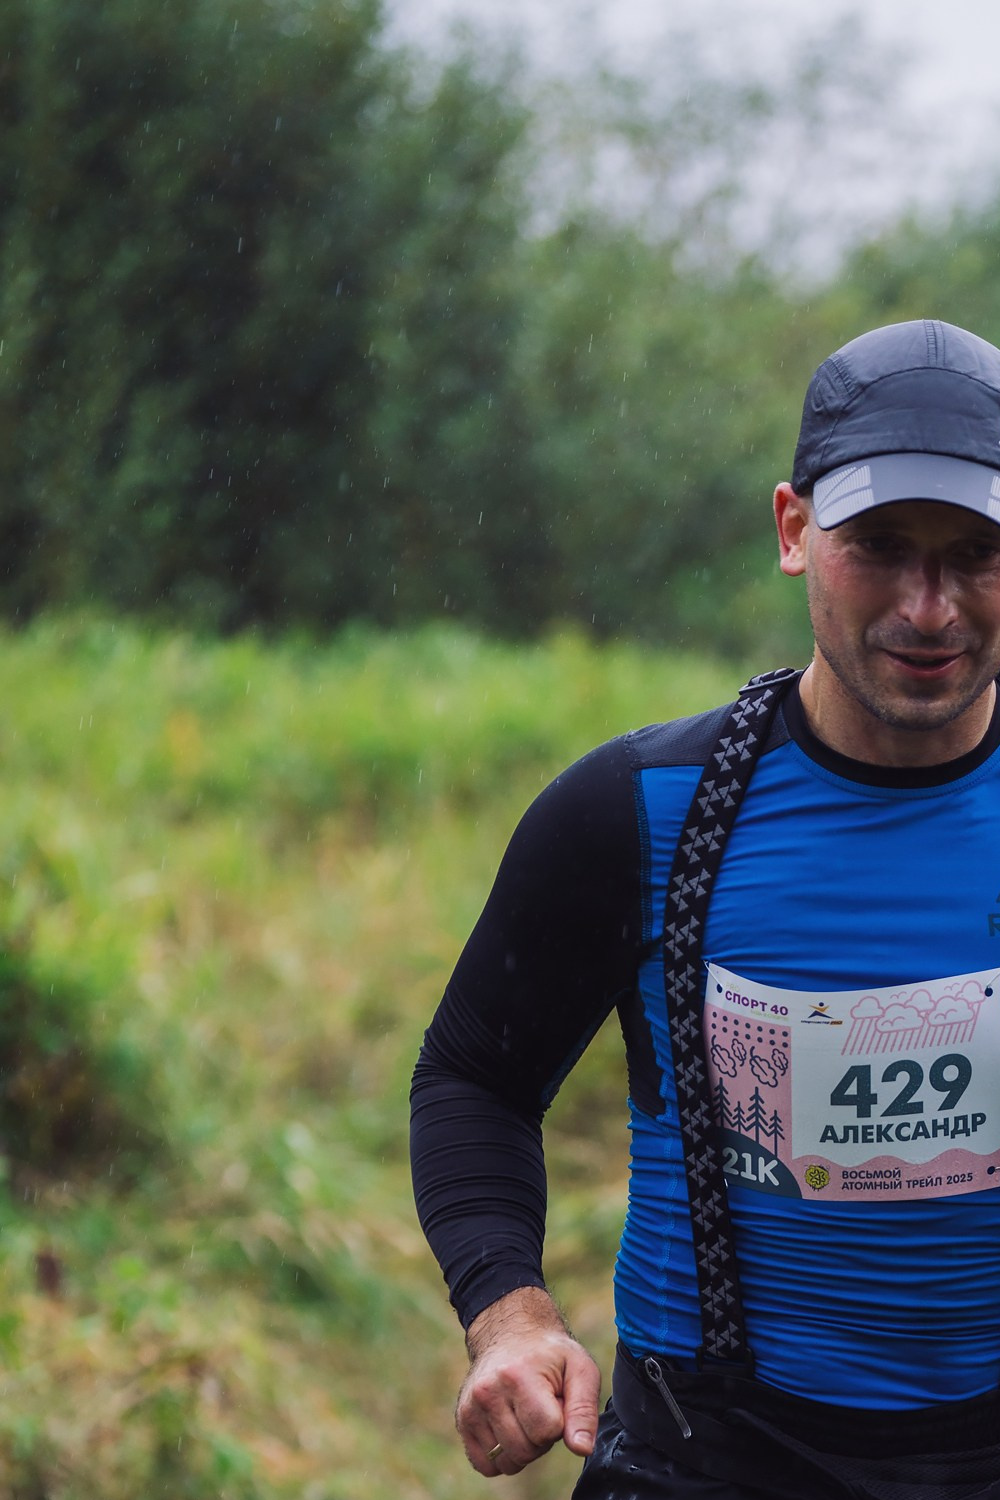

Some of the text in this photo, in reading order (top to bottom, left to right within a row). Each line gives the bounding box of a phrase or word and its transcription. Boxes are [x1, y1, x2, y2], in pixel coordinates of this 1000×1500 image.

[725, 990, 768, 1012] СПОРТ
[770, 1004, 789, 1016] 40
[830, 1053, 972, 1119] 429
[819, 1112, 987, 1144] АЛЕКСАНДР
[721, 1147, 780, 1187] 21K
[841, 1172, 973, 1191] АТОМНЫЙ ТРЕЙЛ 2025
[842, 1167, 901, 1179] ВОСЬМОЙ
